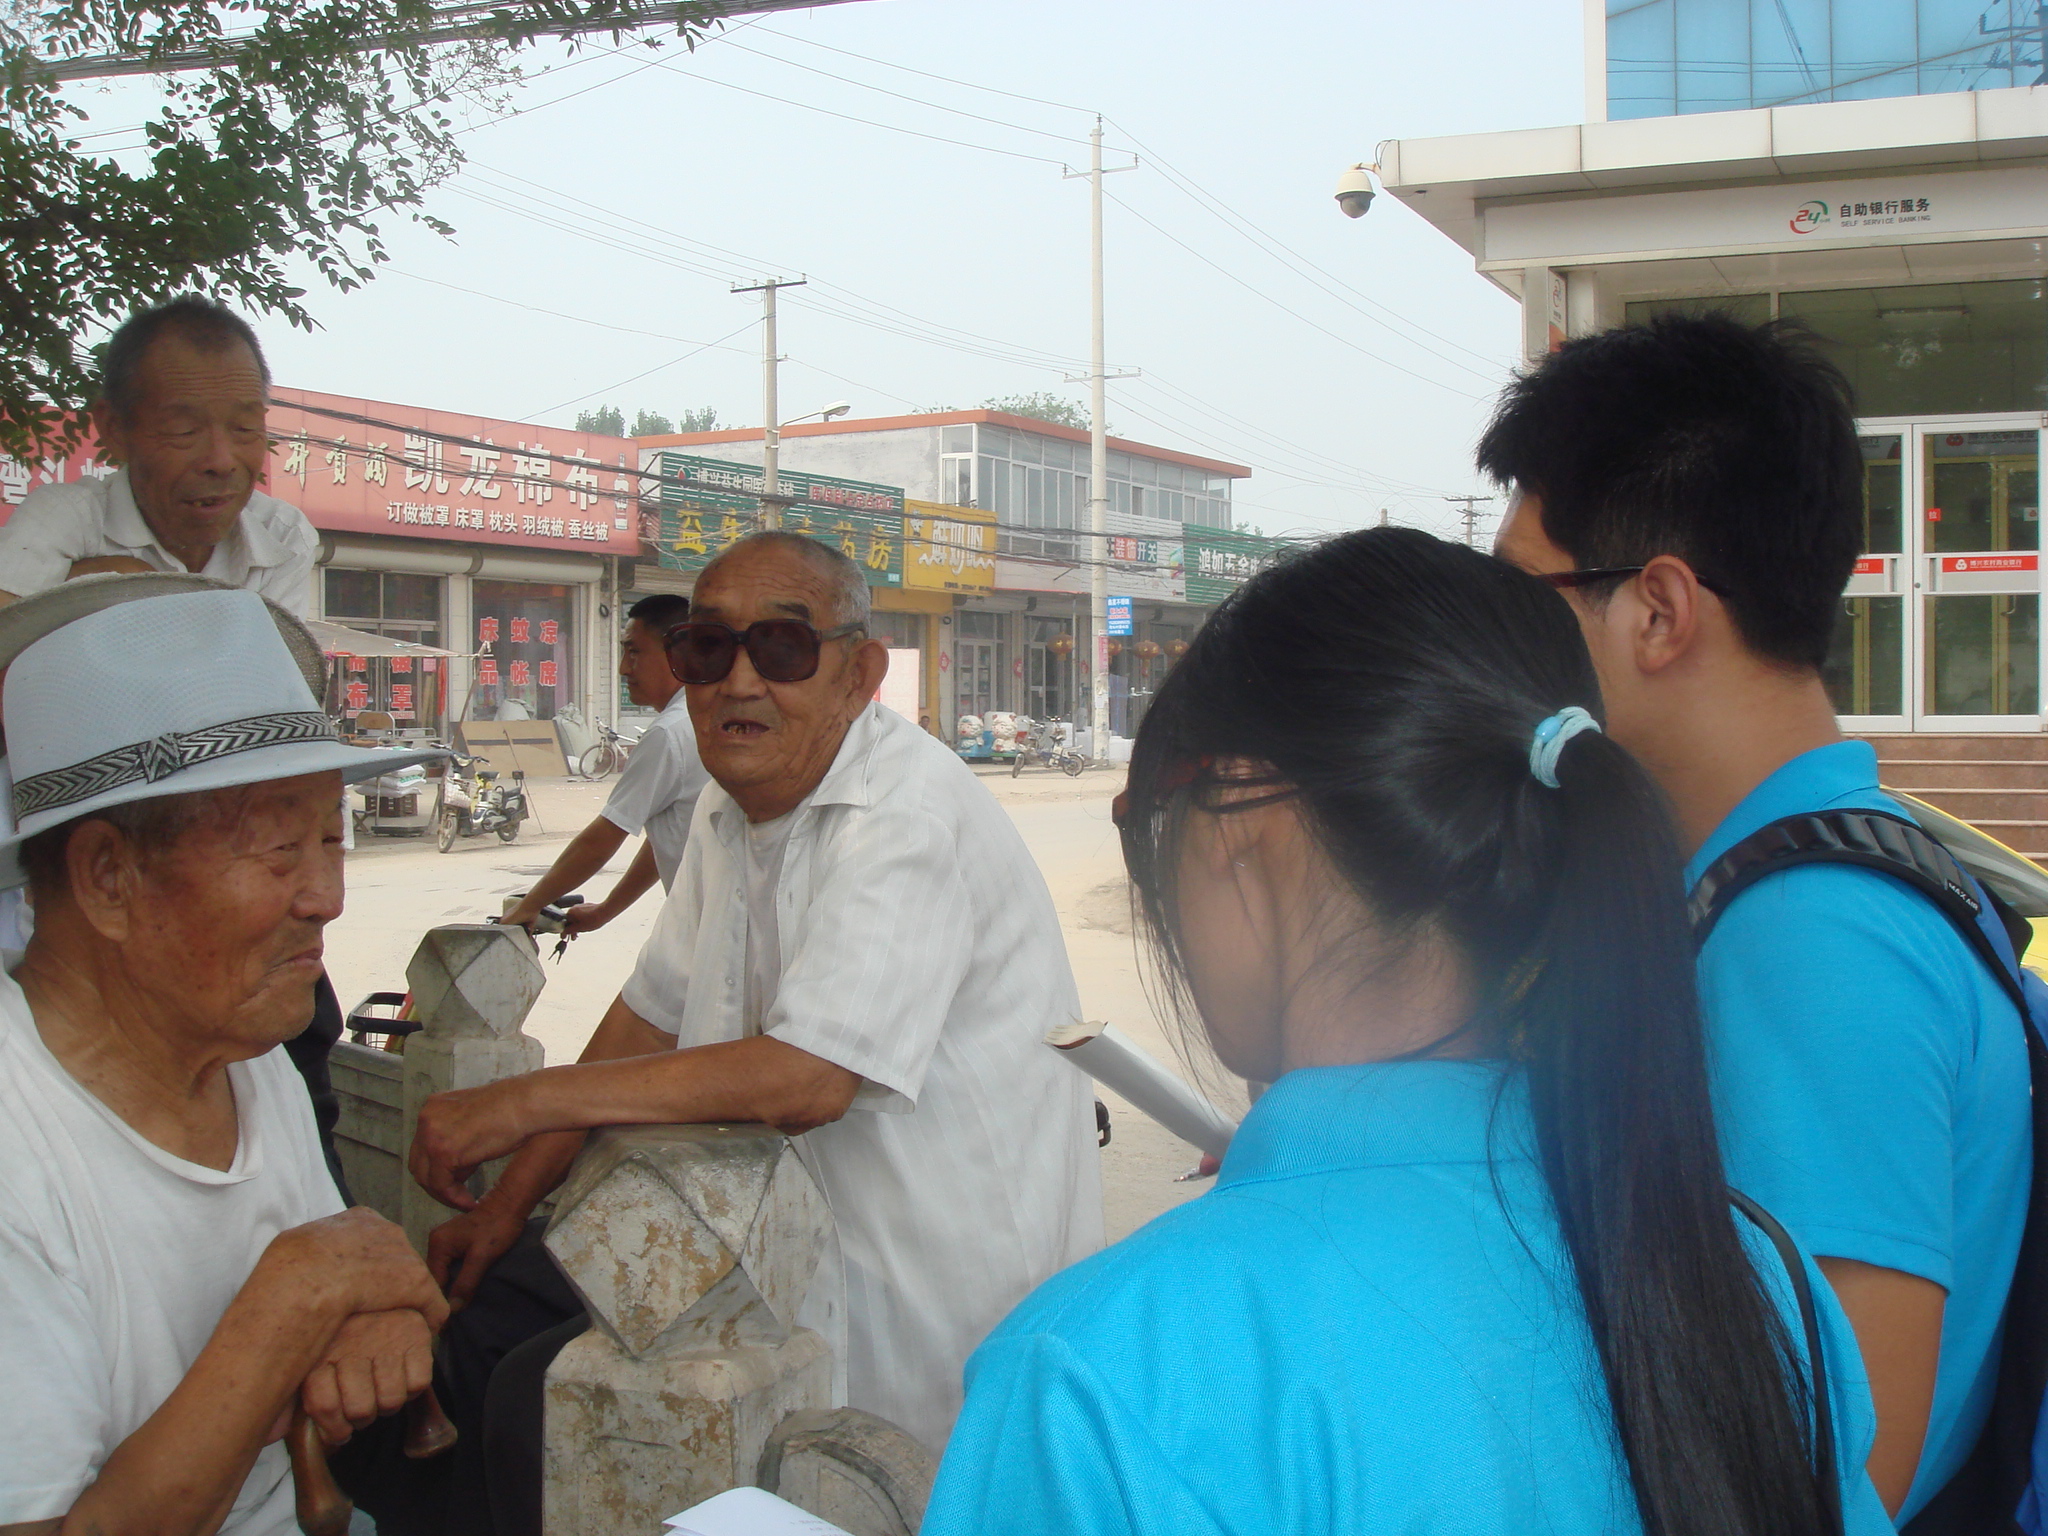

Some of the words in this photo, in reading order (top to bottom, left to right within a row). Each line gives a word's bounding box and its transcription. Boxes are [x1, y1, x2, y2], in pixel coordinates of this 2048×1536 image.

[1840, 198, 1930, 218] 自助银行服务
[1863, 218, 1894, 226] SERVICE
[1898, 215, 1931, 223] BANKING
[404, 426, 602, 511] 凯龙棉布
[387, 501, 450, 527] 订做被罩
[454, 507, 485, 531] 床罩
[489, 510, 518, 534] 枕头
[522, 514, 565, 538] 羽绒被
[568, 519, 609, 542] 蚕丝被
[672, 501, 893, 570] 益生药房
[1198, 547, 1276, 583] 鸿如五金
[479, 616, 499, 686] 床品
[510, 617, 531, 687] 蚊帐
[539, 619, 559, 687] 凉席
[1949, 882, 1967, 900] MAX
[1965, 898, 1978, 911] AIR
